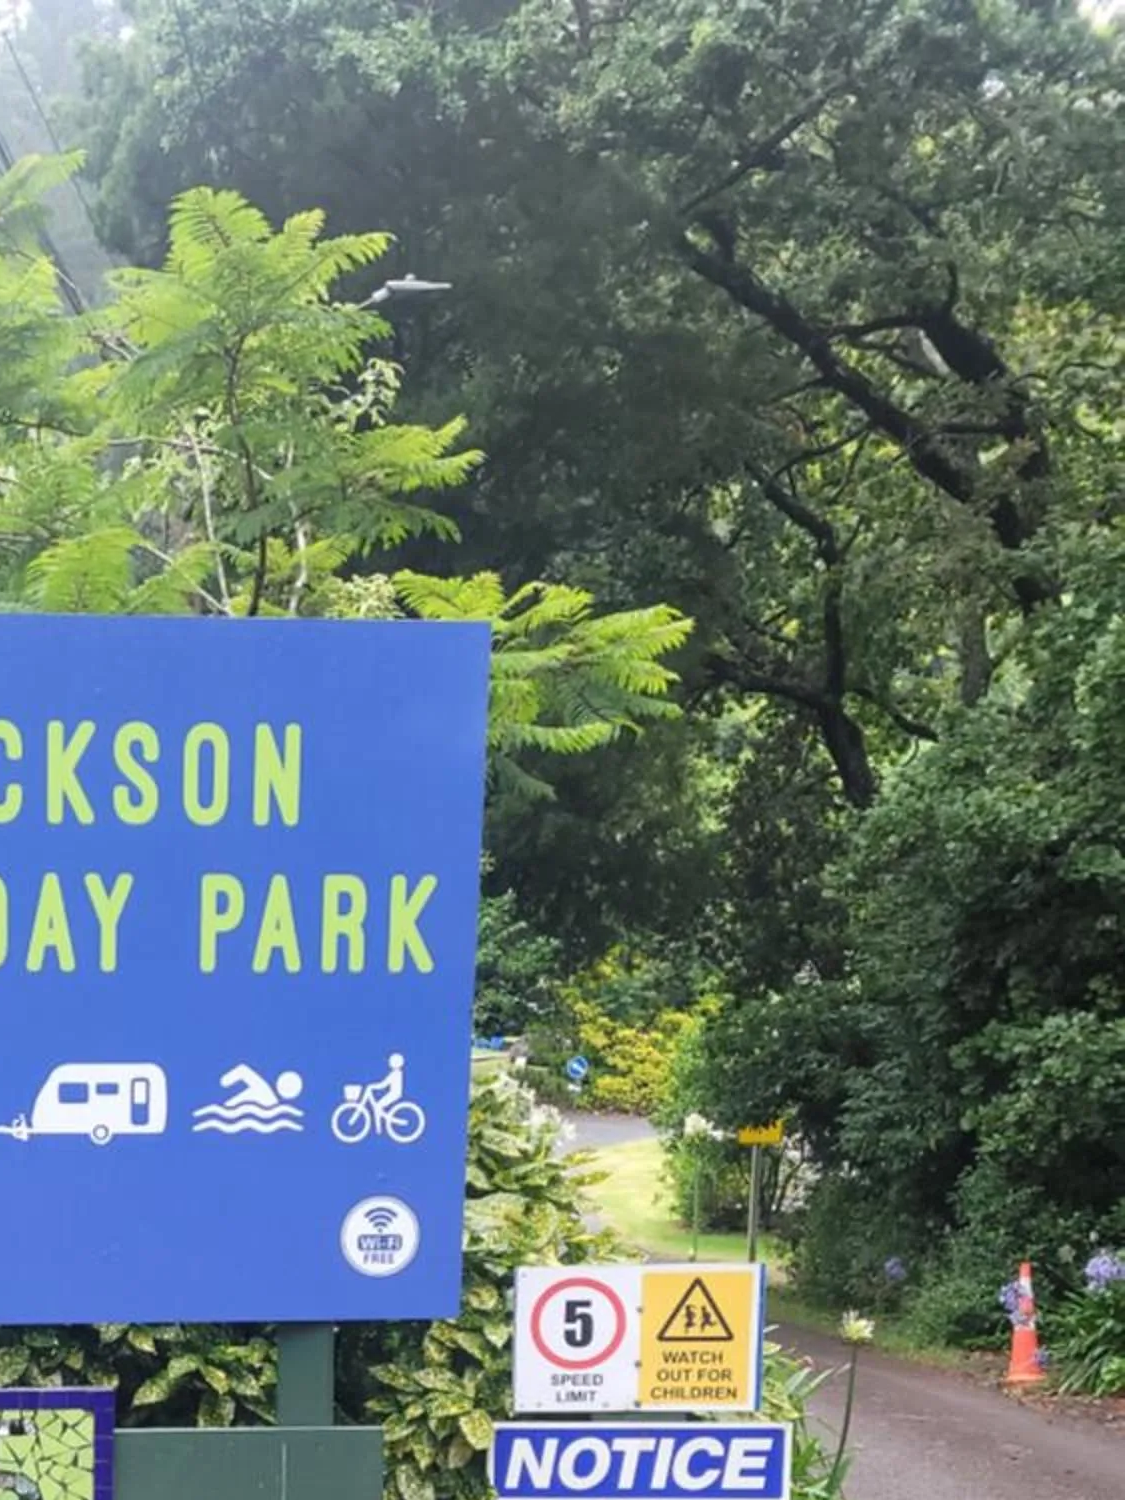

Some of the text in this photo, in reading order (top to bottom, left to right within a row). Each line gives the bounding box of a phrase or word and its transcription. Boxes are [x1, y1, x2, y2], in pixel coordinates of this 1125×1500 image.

[199, 873, 438, 974] PARK
[563, 1300, 595, 1348] 5
[661, 1350, 724, 1365] WATCH
[550, 1373, 604, 1387] SPEED
[656, 1369, 732, 1382] OUT FOR
[556, 1390, 597, 1402] LIMIT
[650, 1386, 737, 1400] CHILDREN
[504, 1437, 774, 1490] NOTICE
